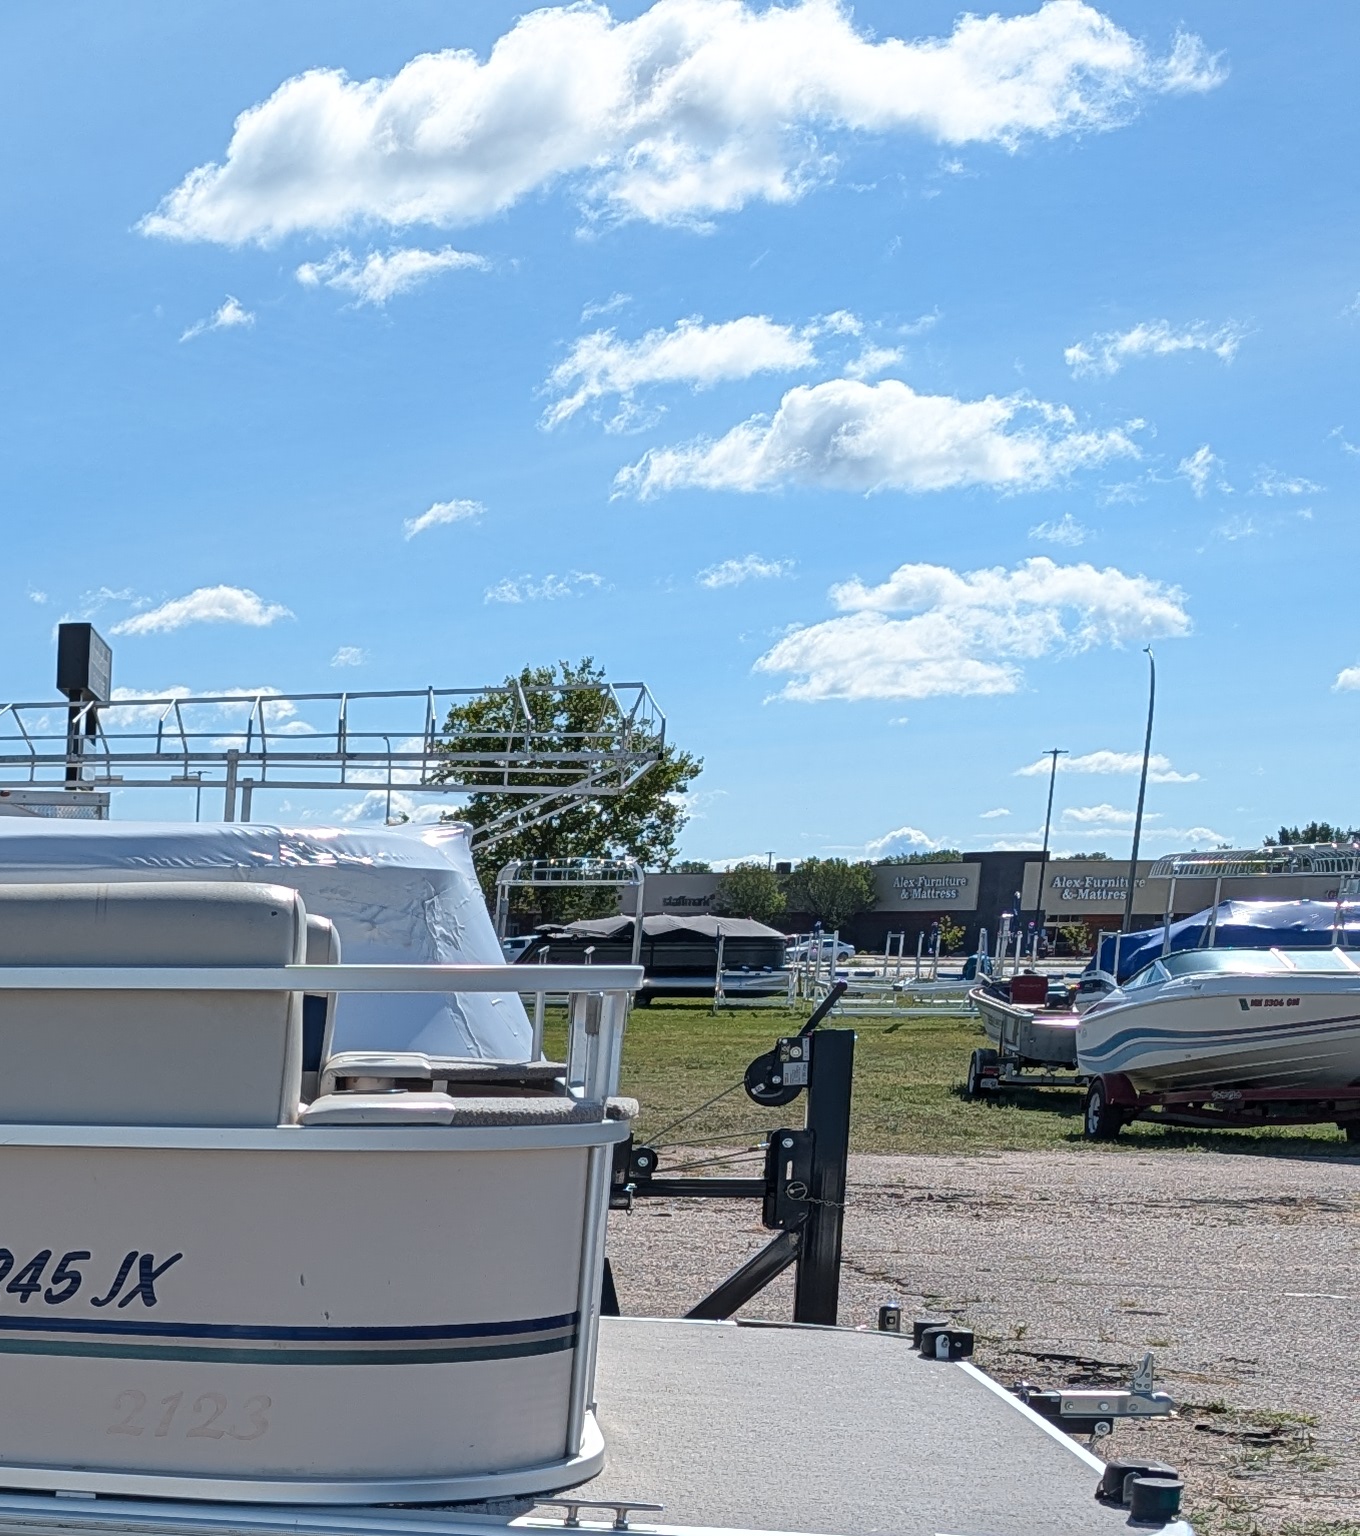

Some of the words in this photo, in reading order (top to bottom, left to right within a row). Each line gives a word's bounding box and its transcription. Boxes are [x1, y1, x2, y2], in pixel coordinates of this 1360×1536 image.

[893, 876, 915, 888] Alex
[917, 875, 967, 887] Furniture
[1052, 876, 1081, 888] Alex
[900, 888, 909, 899] &
[911, 887, 957, 899] Mattress
[1062, 888, 1073, 900] &
[1077, 888, 1128, 900] Mattres
[90, 1250, 183, 1309] JX
[105, 1389, 273, 1441] 2123
